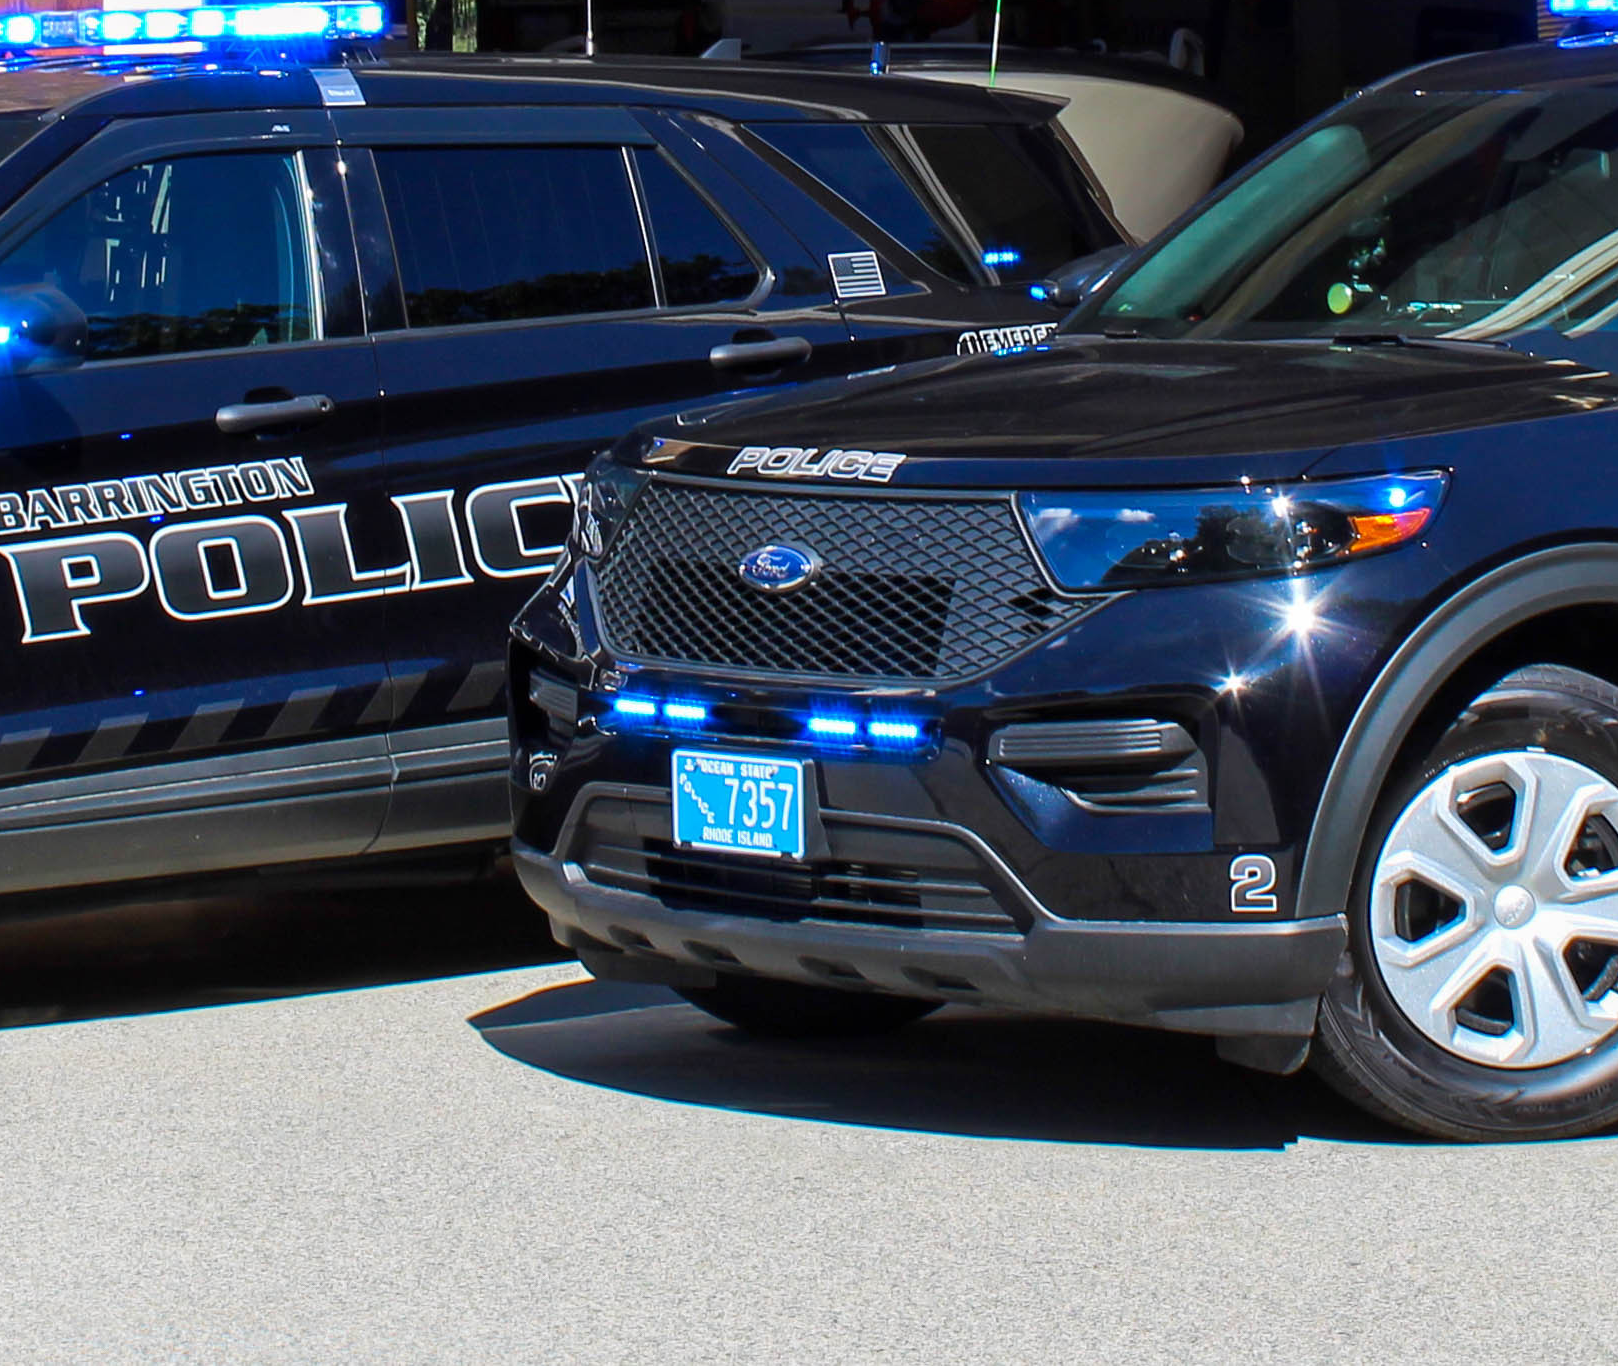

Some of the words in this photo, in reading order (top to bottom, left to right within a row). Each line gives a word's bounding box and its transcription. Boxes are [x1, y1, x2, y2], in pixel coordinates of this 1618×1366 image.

[726, 447, 907, 483] POLICE
[724, 777, 794, 831] 7357
[702, 825, 734, 843] RHODE
[737, 829, 773, 848] ISLAND
[1229, 854, 1278, 913] 2
